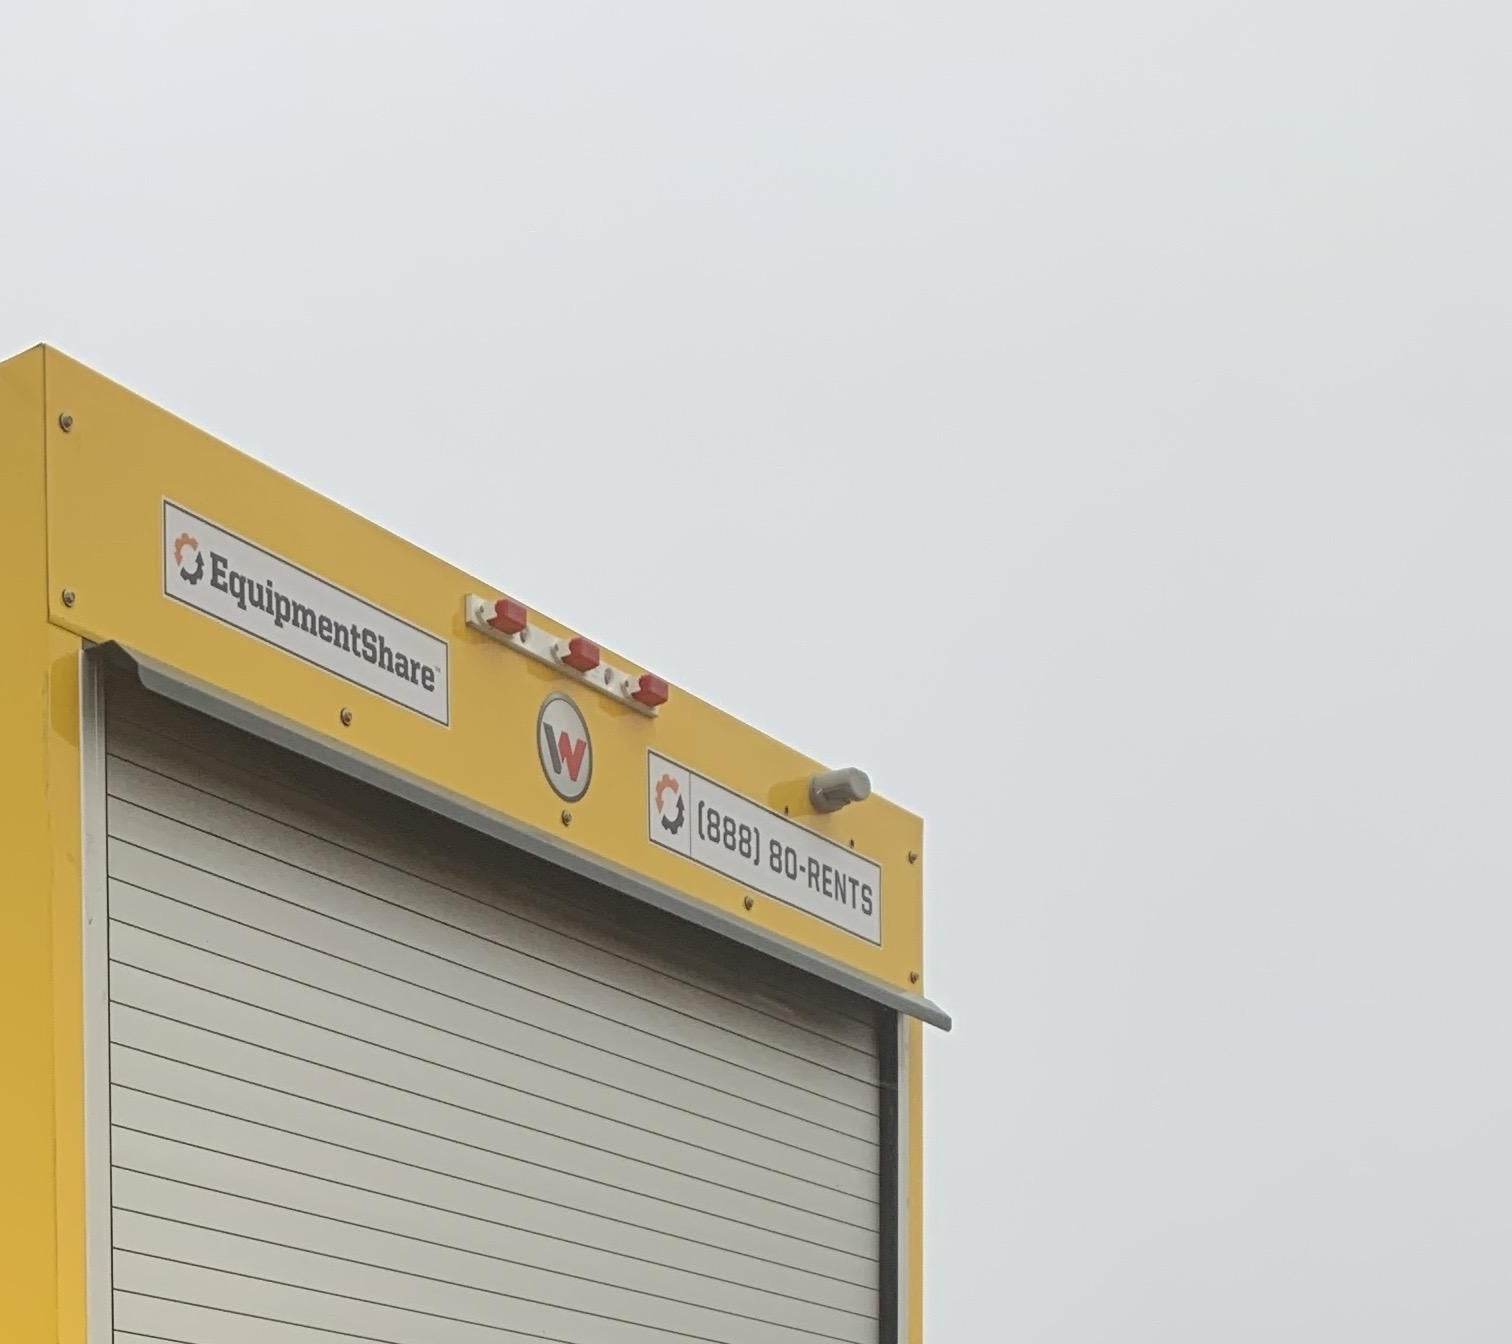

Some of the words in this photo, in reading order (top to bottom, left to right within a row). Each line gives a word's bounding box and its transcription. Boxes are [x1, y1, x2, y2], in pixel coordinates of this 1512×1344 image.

[210, 551, 435, 693] EquipmentShare
[698, 800, 760, 866] (888)
[769, 839, 873, 917] 80-RENTS
